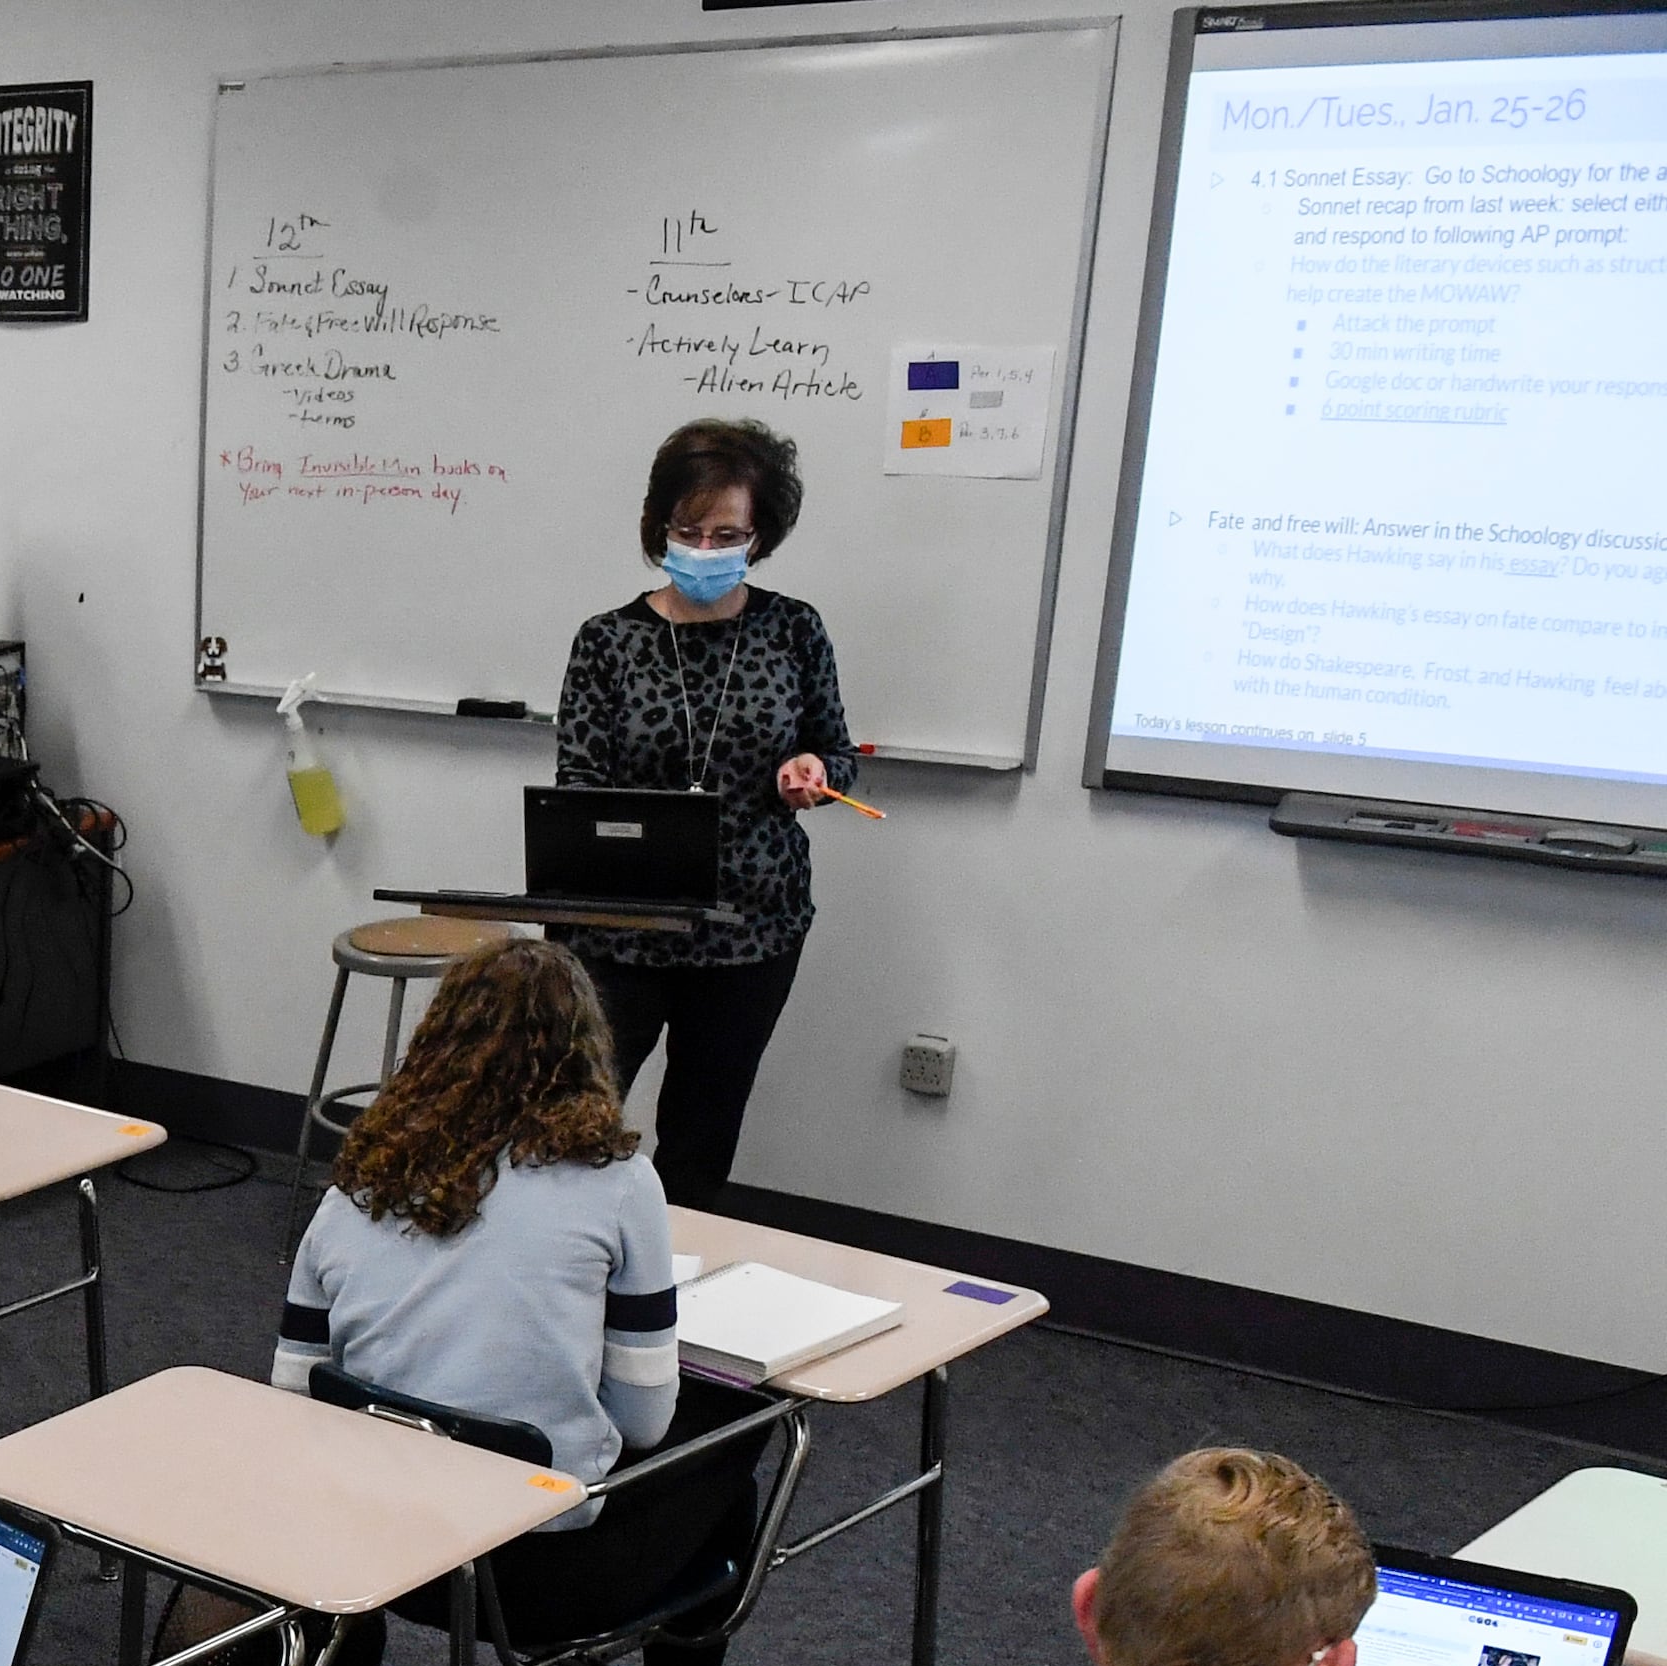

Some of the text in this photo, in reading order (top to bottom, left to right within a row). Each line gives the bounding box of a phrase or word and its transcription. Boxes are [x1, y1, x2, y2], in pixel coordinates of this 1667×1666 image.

[1417, 93, 1478, 124] Jan.
[1491, 88, 1586, 128] 25-26
[1251, 171, 1276, 187] 4.1
[1283, 169, 1345, 187] Sonnet
[1352, 167, 1412, 189] Essay:
[1426, 166, 1451, 185] Go
[1459, 168, 1474, 183] to
[1482, 164, 1581, 187] Schoology
[1587, 163, 1615, 182] for
[1620, 163, 1649, 182] the
[1298, 198, 1360, 216] Sonnet
[1366, 200, 1417, 218] recap
[1423, 196, 1463, 213] from
[1470, 195, 1503, 213] last
[1571, 194, 1627, 212] select
[268, 214, 331, 251] 12th
[663, 209, 717, 253] 11th
[1294, 225, 1629, 248] and respond to following AP prompt:
[21, 264, 65, 287] ONE
[1291, 255, 1331, 273] How
[1335, 257, 1358, 273] do
[1362, 256, 1390, 273] the
[1394, 255, 1460, 275] literary
[1463, 255, 1532, 274] devices
[1537, 255, 1579, 274] such
[1584, 258, 1604, 274] as
[250, 264, 388, 309] Sonnet Essay
[787, 281, 871, 307] ICAP
[1286, 284, 1521, 305] help create the MOWAW?
[364, 308, 404, 333] Will
[1332, 313, 1496, 335] Attack the prompt
[749, 326, 829, 367] Learn
[1330, 342, 1500, 365] 30 min writing time
[251, 344, 319, 377] Greek
[324, 349, 396, 380] Drama
[772, 369, 863, 400] Article
[1325, 371, 1386, 392] Google
[1391, 371, 1425, 391] doc
[1428, 375, 1445, 390] or
[1451, 372, 1544, 394] handwrite
[1548, 376, 1591, 396] your
[1322, 399, 1508, 421] 6 point scoring rubric
[919, 426, 931, 442] B
[300, 454, 374, 475] Invisible
[433, 453, 481, 476] books
[488, 466, 507, 483] on
[288, 486, 324, 498] next
[336, 485, 422, 504] in-person
[1209, 511, 1244, 529] Fate
[1252, 514, 1282, 532] and
[1287, 515, 1321, 533] free
[1325, 518, 1359, 535] will:
[1363, 519, 1430, 538] Answer
[1434, 521, 1450, 539] in
[1455, 522, 1484, 541] the
[1489, 524, 1582, 549] Schoology
[1254, 540, 1637, 581] What does Hawking say in his essay? Do you
[1249, 570, 1286, 589] why.
[1245, 594, 1283, 613] How
[1287, 595, 1327, 616] does
[1332, 600, 1419, 626] Hawking's
[1423, 608, 1471, 629] essay
[1475, 612, 1498, 627] on
[1503, 610, 1537, 630] fate
[1542, 618, 1622, 638] compare
[1627, 622, 1647, 638] to
[1243, 620, 1321, 646] "Design"?
[1238, 649, 1276, 668] How
[1279, 651, 1301, 670] do
[1478, 669, 1512, 686] and
[1516, 670, 1595, 696] Hawking
[1604, 676, 1638, 696] feel
[1234, 678, 1451, 709] with the human condition.
[1135, 714, 1366, 745] Today's lesson continues on slide 5
